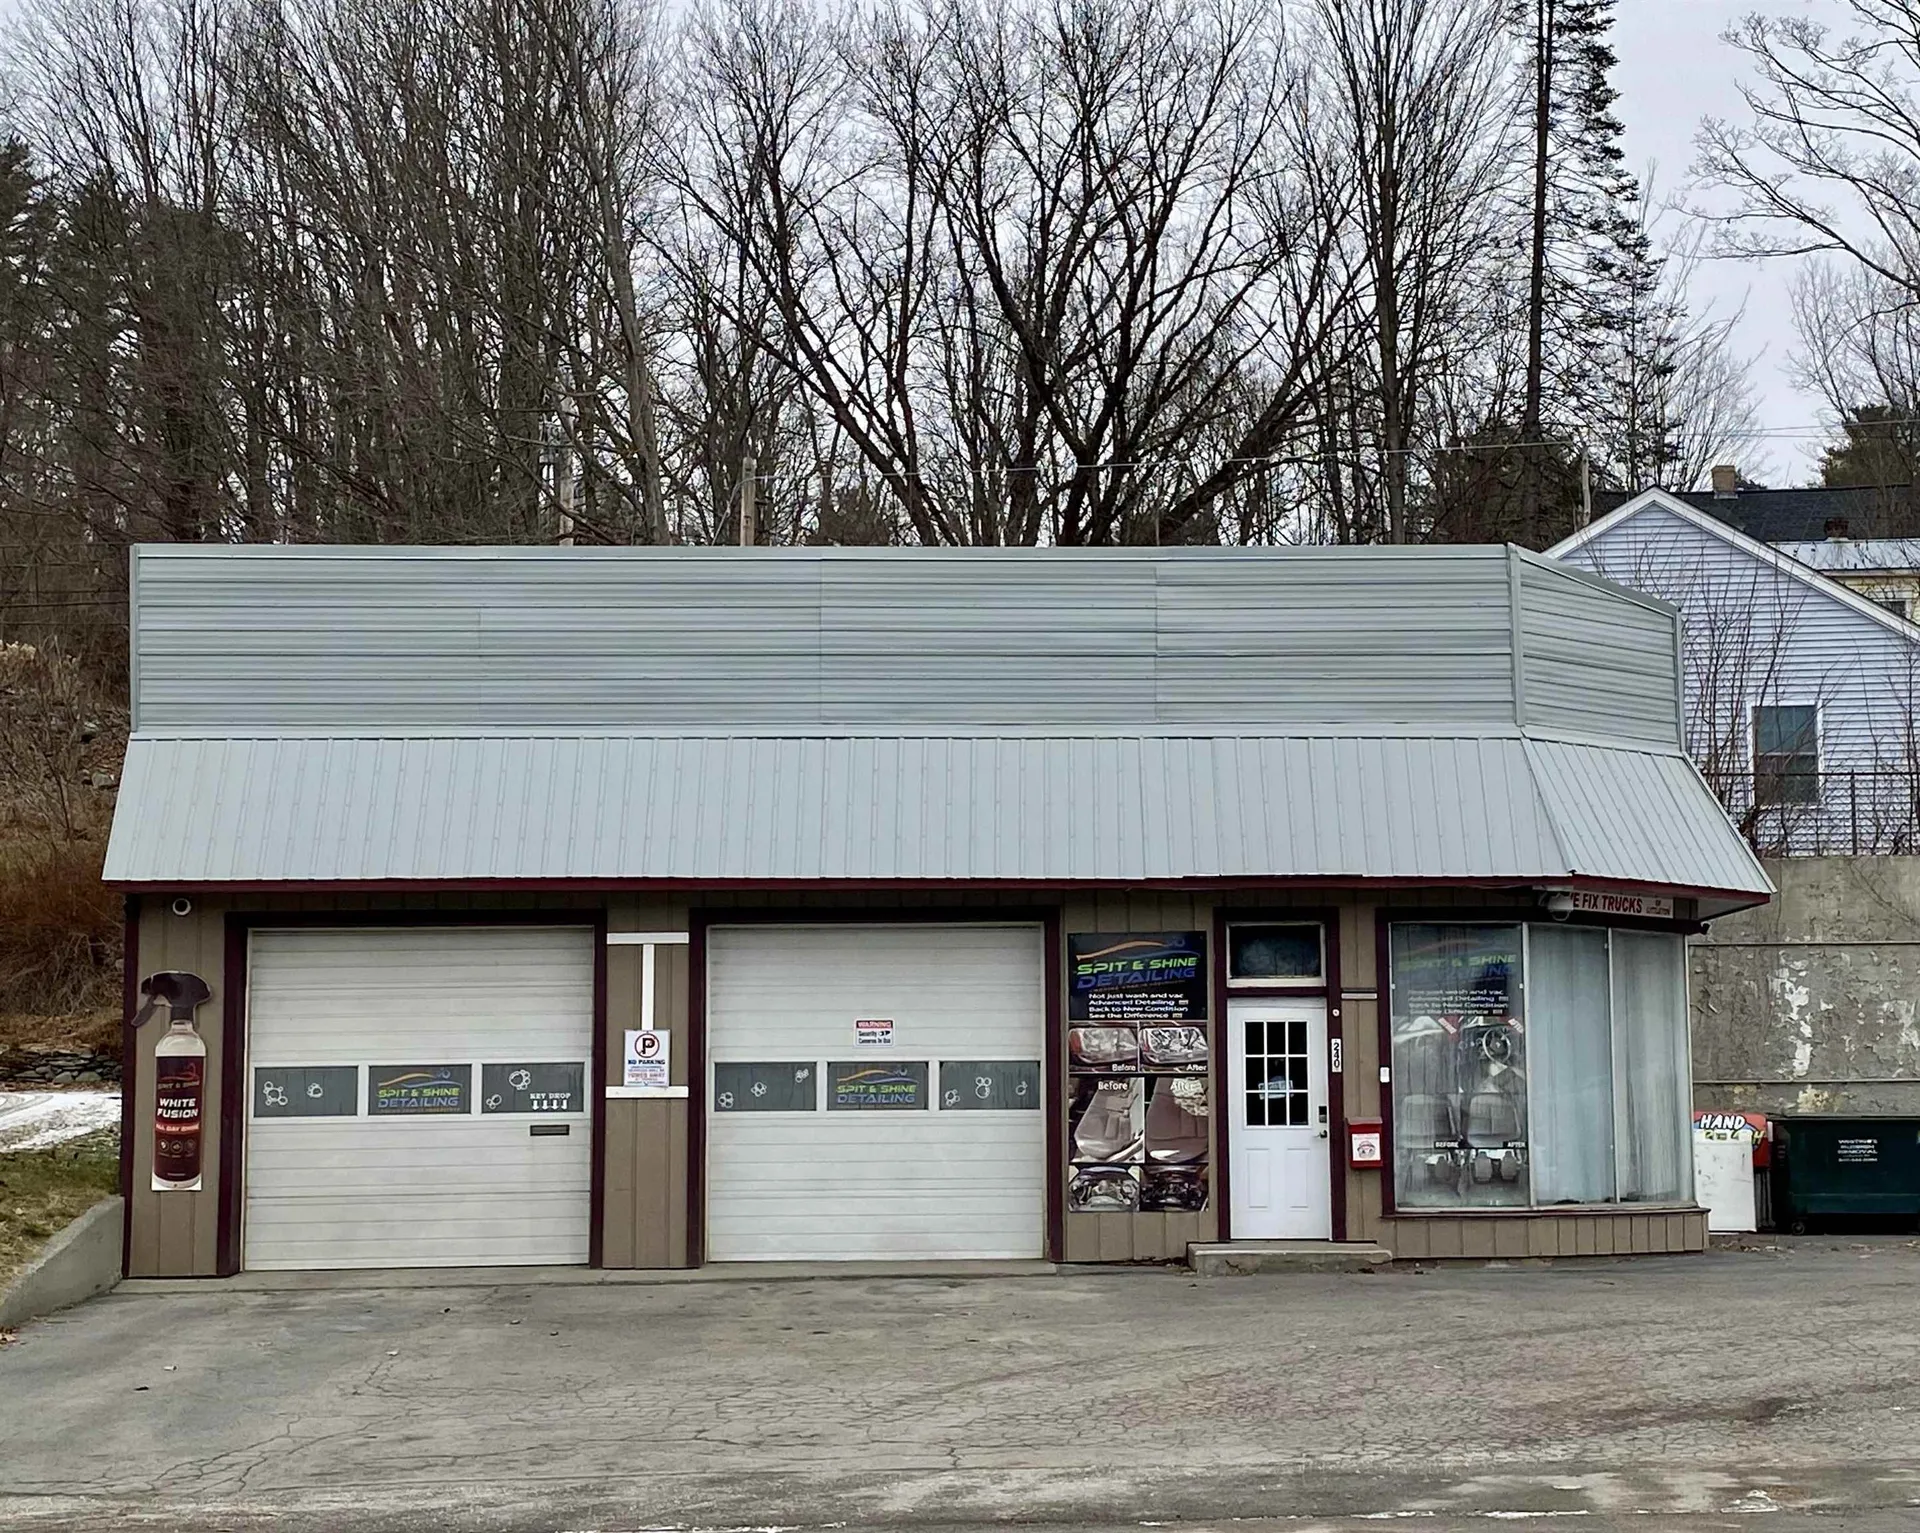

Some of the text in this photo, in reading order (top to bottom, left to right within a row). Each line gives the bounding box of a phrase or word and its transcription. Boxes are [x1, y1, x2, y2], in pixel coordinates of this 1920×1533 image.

[1582, 894, 1599, 910] FIX
[1601, 894, 1643, 914] TRUCKS
[1468, 954, 1517, 966] SHINE
[1077, 957, 1198, 975] SPIT & SHINE
[1077, 967, 1196, 989] DETAILING
[1112, 1063, 1137, 1072] Before
[836, 1084, 917, 1093] SPIT & SHINE
[1097, 1080, 1128, 1091] Before
[377, 1087, 460, 1098] SPIT & SHINE
[160, 1098, 197, 1107] WHITE
[377, 1096, 459, 1108] DETAILING
[836, 1094, 915, 1104] DETAILING
[157, 1108, 199, 1119] FUSION
[1700, 1113, 1746, 1130] HAND
